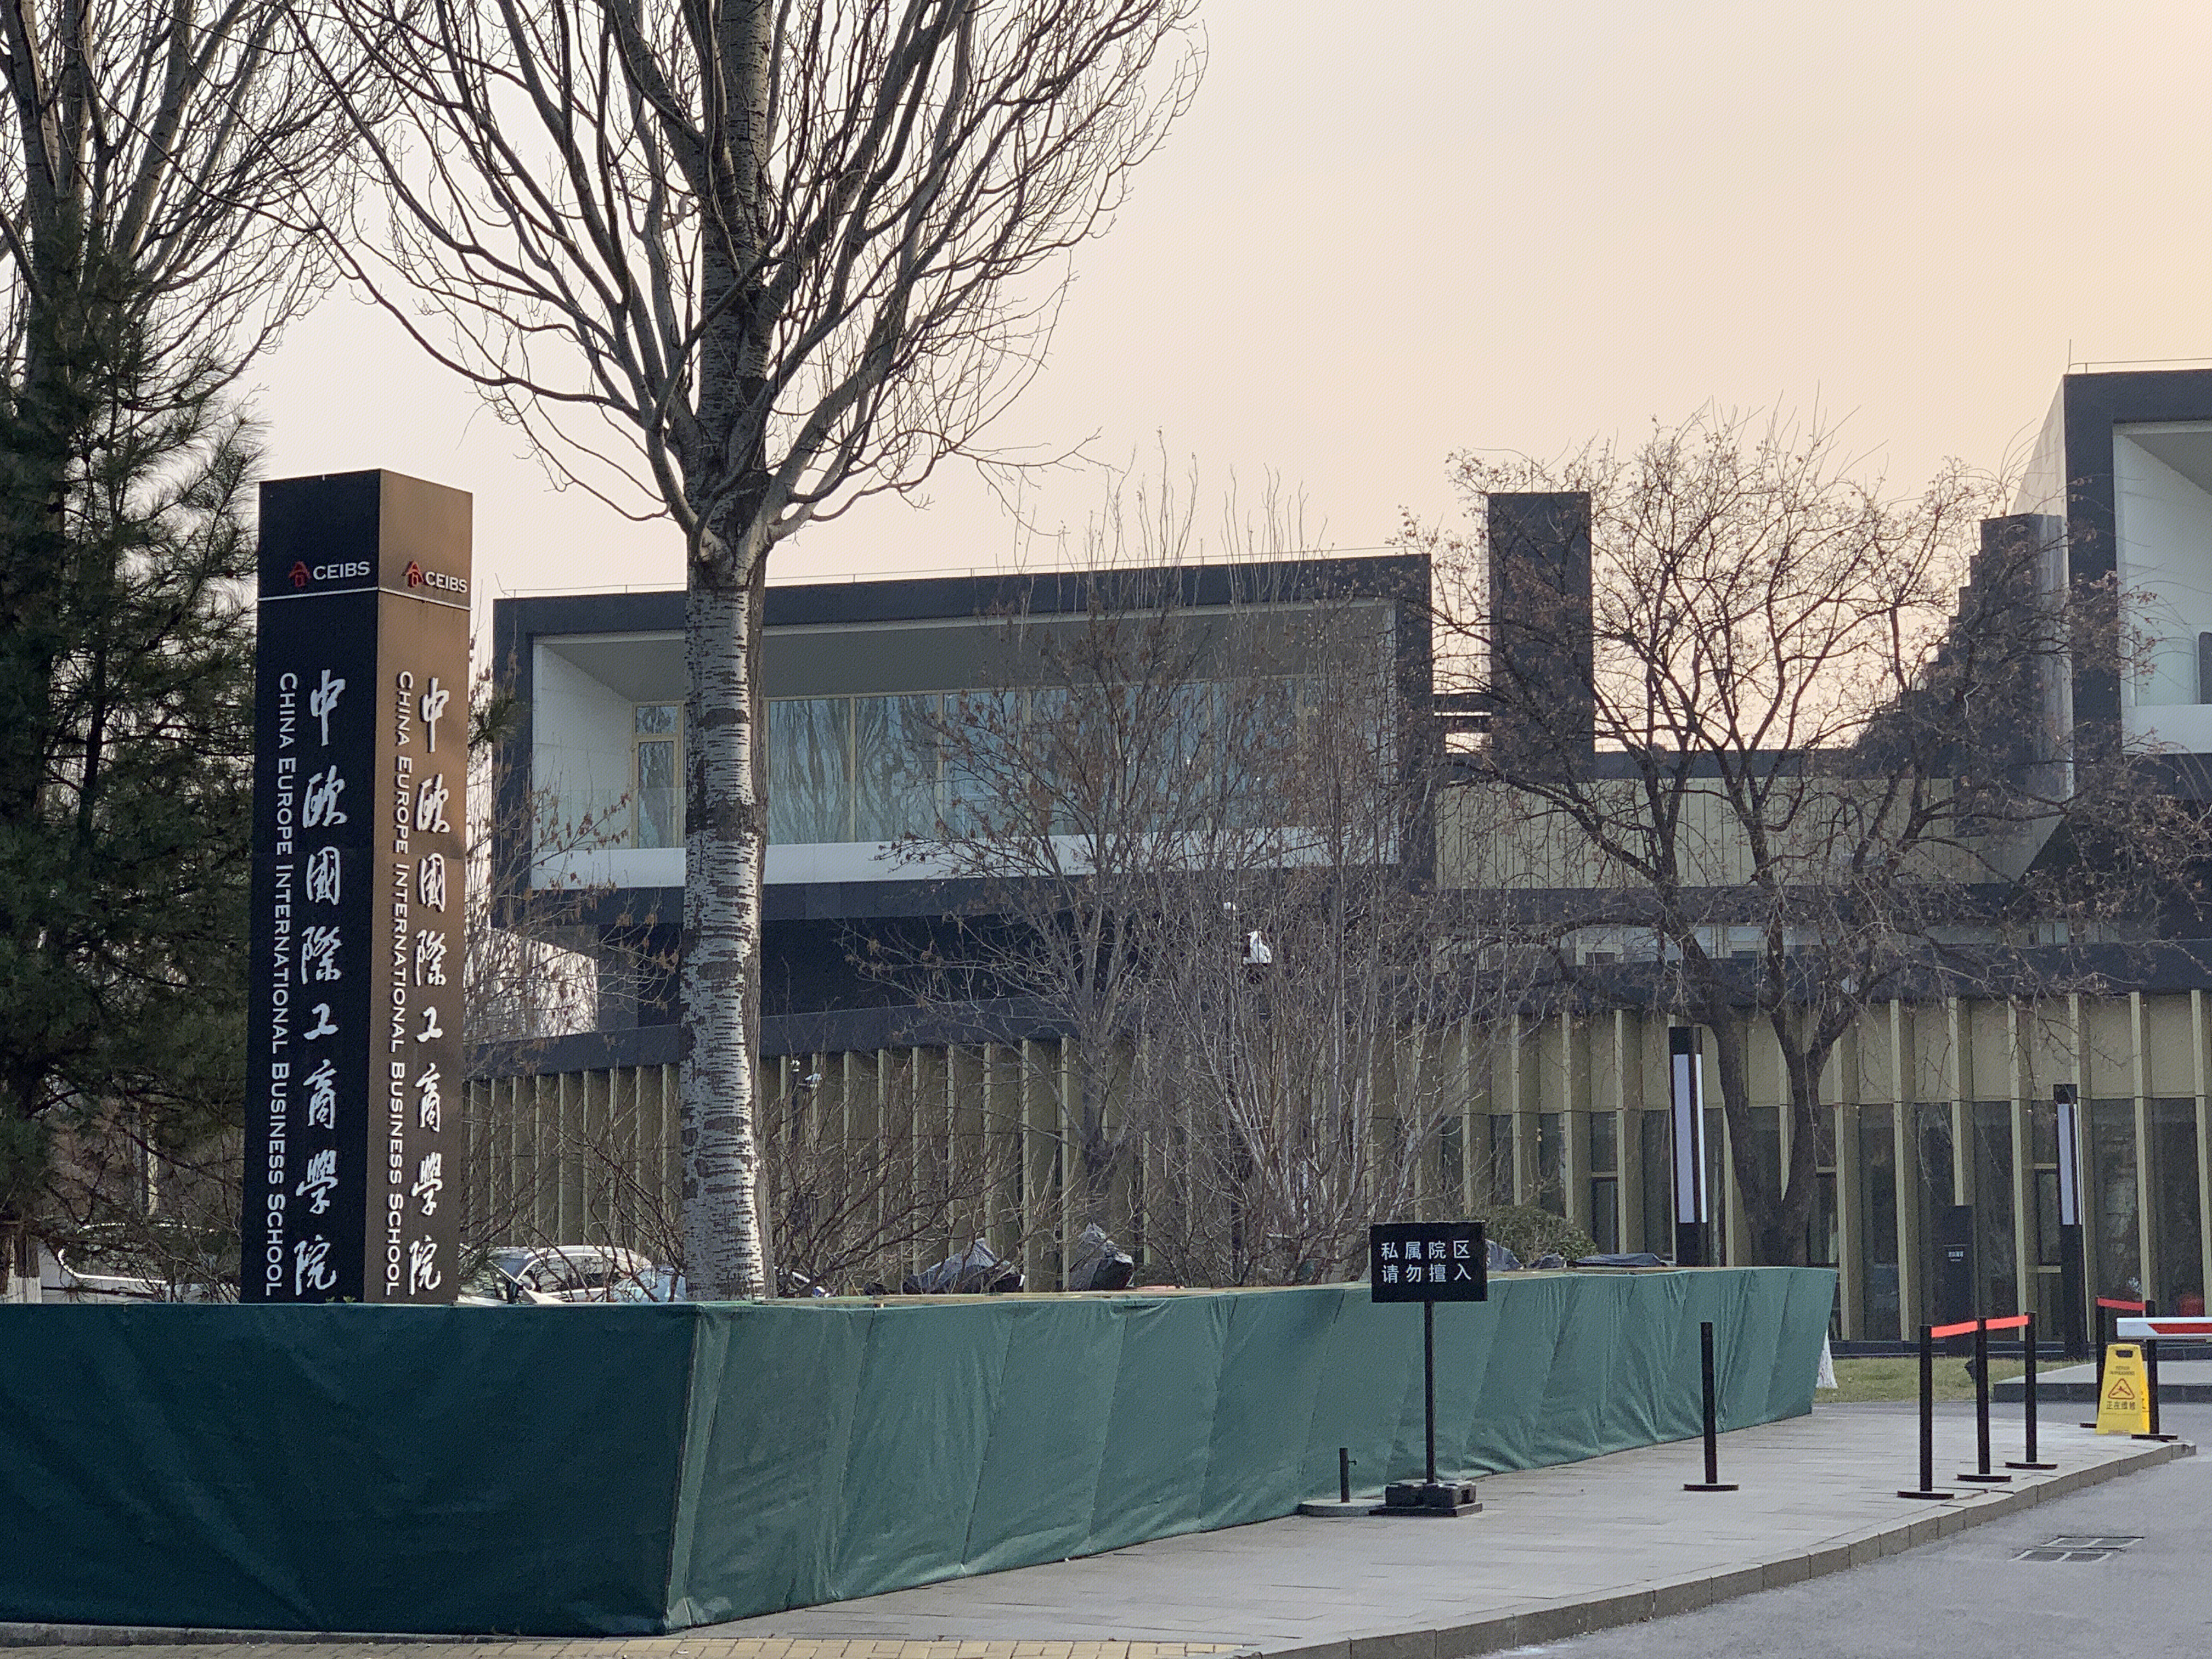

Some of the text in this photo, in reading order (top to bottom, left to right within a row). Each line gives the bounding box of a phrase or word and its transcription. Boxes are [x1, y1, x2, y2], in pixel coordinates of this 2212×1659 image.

[313, 561, 371, 580] CEIBS
[425, 571, 467, 593] CEIBS
[266, 672, 298, 1296] CHINA EUROPE INTERNATIONAL BUSINESS SCHOOL
[386, 670, 414, 1296] CHINA EUROPE INTERNATIONAL BUSINESS SCHOOL
[1380, 1239, 1471, 1261] 私属院区
[1381, 1263, 1471, 1284] 请勿擅入
